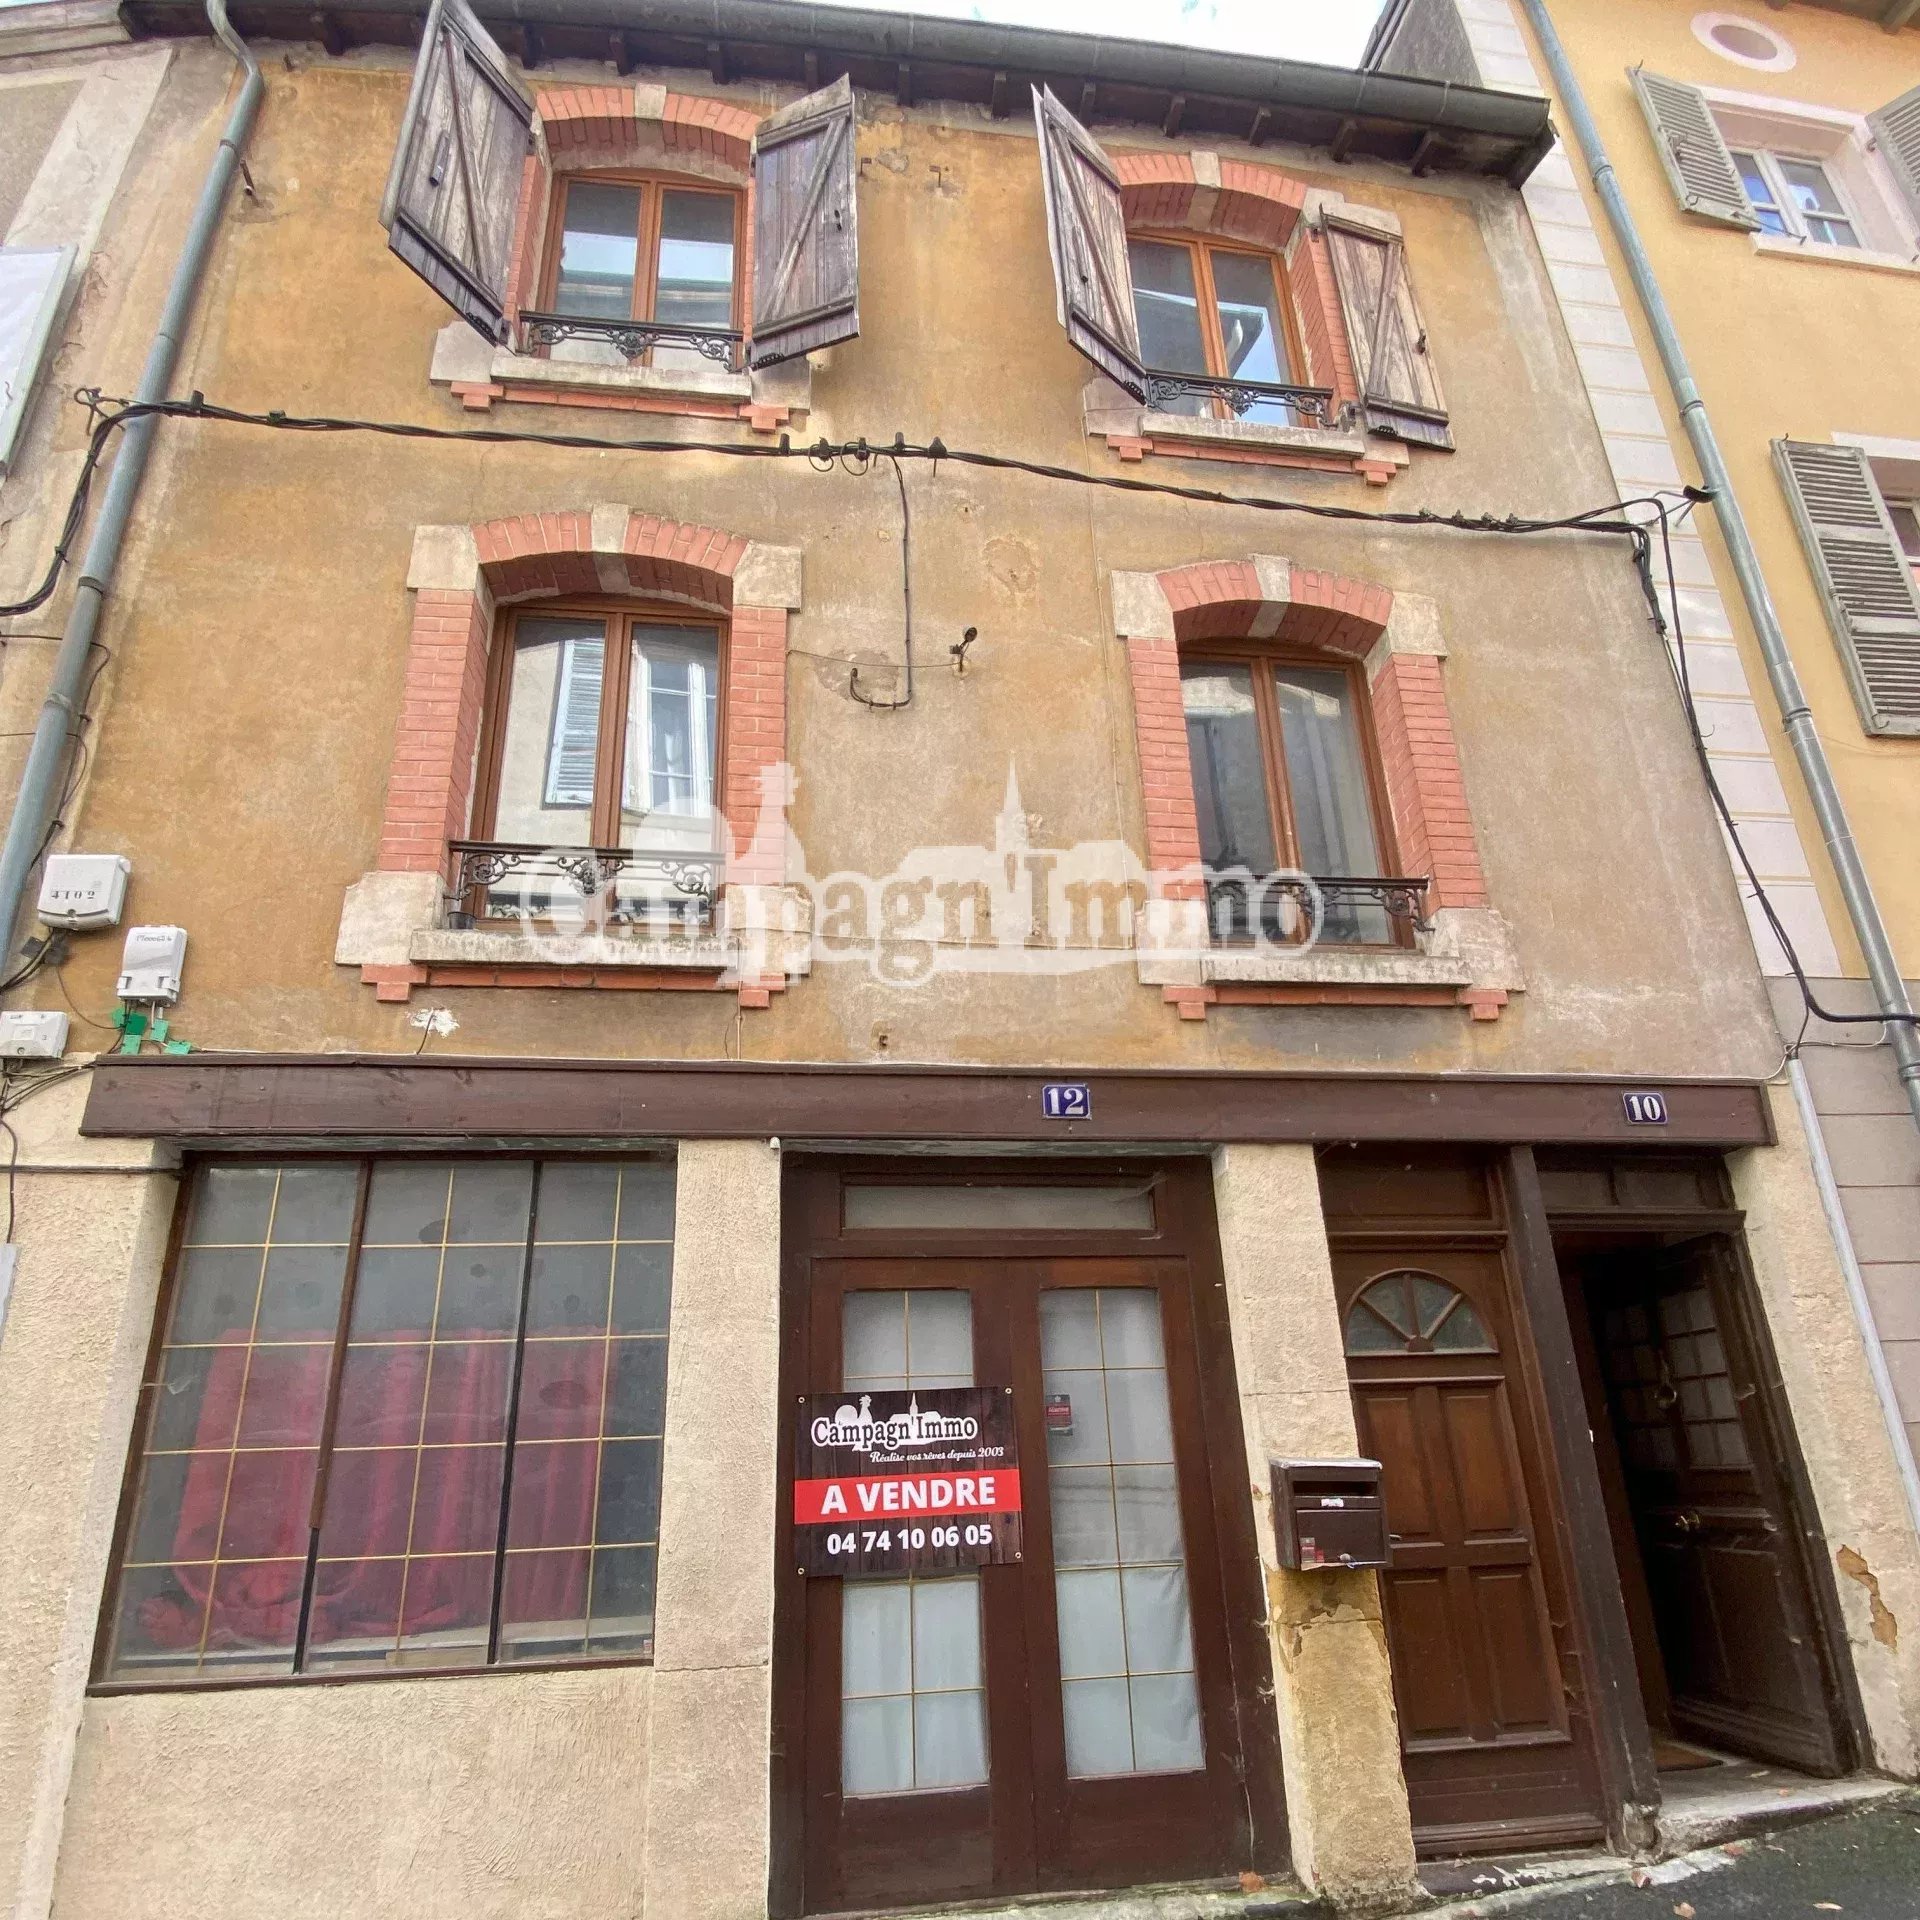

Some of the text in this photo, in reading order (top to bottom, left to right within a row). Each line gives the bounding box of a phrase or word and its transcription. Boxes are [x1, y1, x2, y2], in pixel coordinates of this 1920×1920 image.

[51, 890, 95, 900] 4102
[1047, 1087, 1084, 1115] 12
[1629, 1095, 1661, 1121] 10
[813, 1414, 976, 1450] Campagn'Immo
[869, 1451, 905, 1463] Réalise
[906, 1452, 922, 1461] vos
[922, 1451, 946, 1461] rêves
[946, 1449, 977, 1462] depuis
[820, 1475, 996, 1516] A VENDRE
[826, 1523, 993, 1556] 04 74 10 06 05
